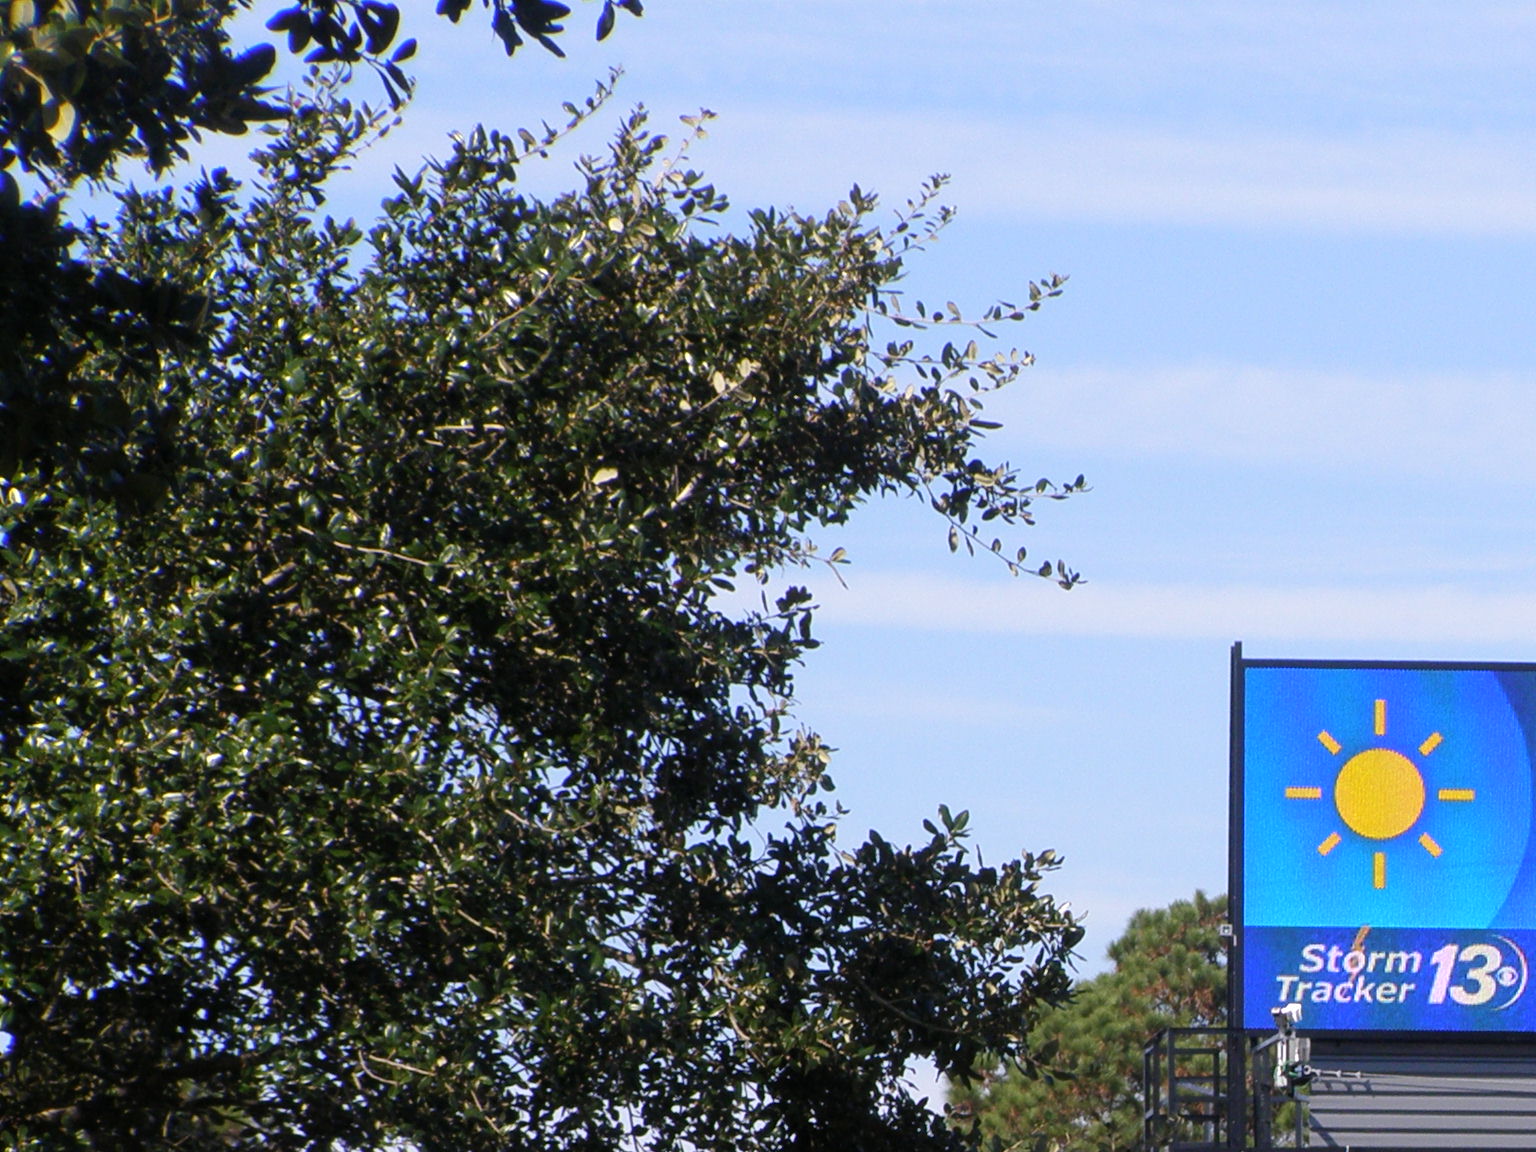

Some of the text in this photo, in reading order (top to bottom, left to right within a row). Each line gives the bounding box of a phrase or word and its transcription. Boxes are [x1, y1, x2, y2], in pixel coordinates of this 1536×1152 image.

[1276, 974, 1416, 1004] Tracker
[1299, 942, 1502, 1006] Storm 13
